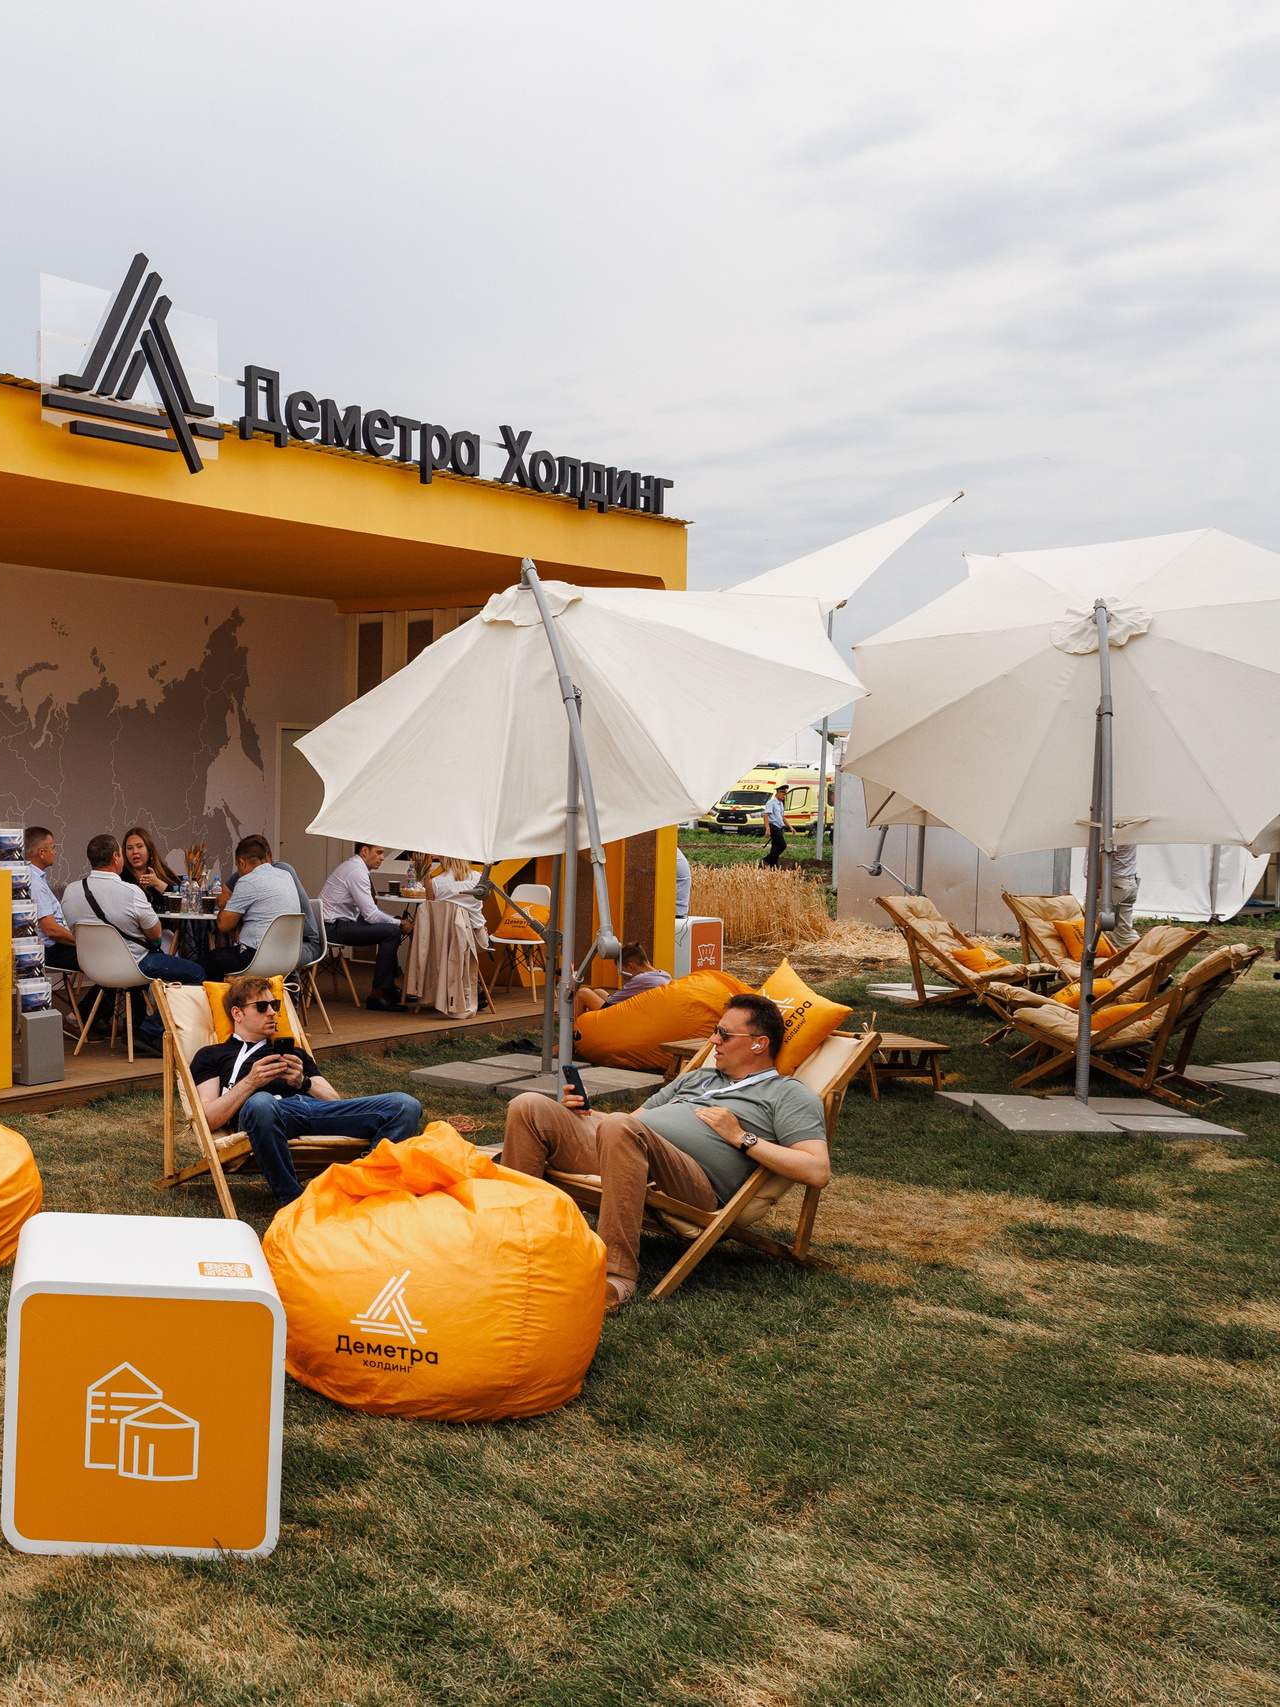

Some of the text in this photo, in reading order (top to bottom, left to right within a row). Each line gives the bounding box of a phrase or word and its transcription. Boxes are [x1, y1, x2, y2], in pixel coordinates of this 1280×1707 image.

[239, 365, 674, 514] Деметра Холдинг
[336, 1334, 438, 1365] Деметра
[362, 1359, 413, 1374] холдинг
